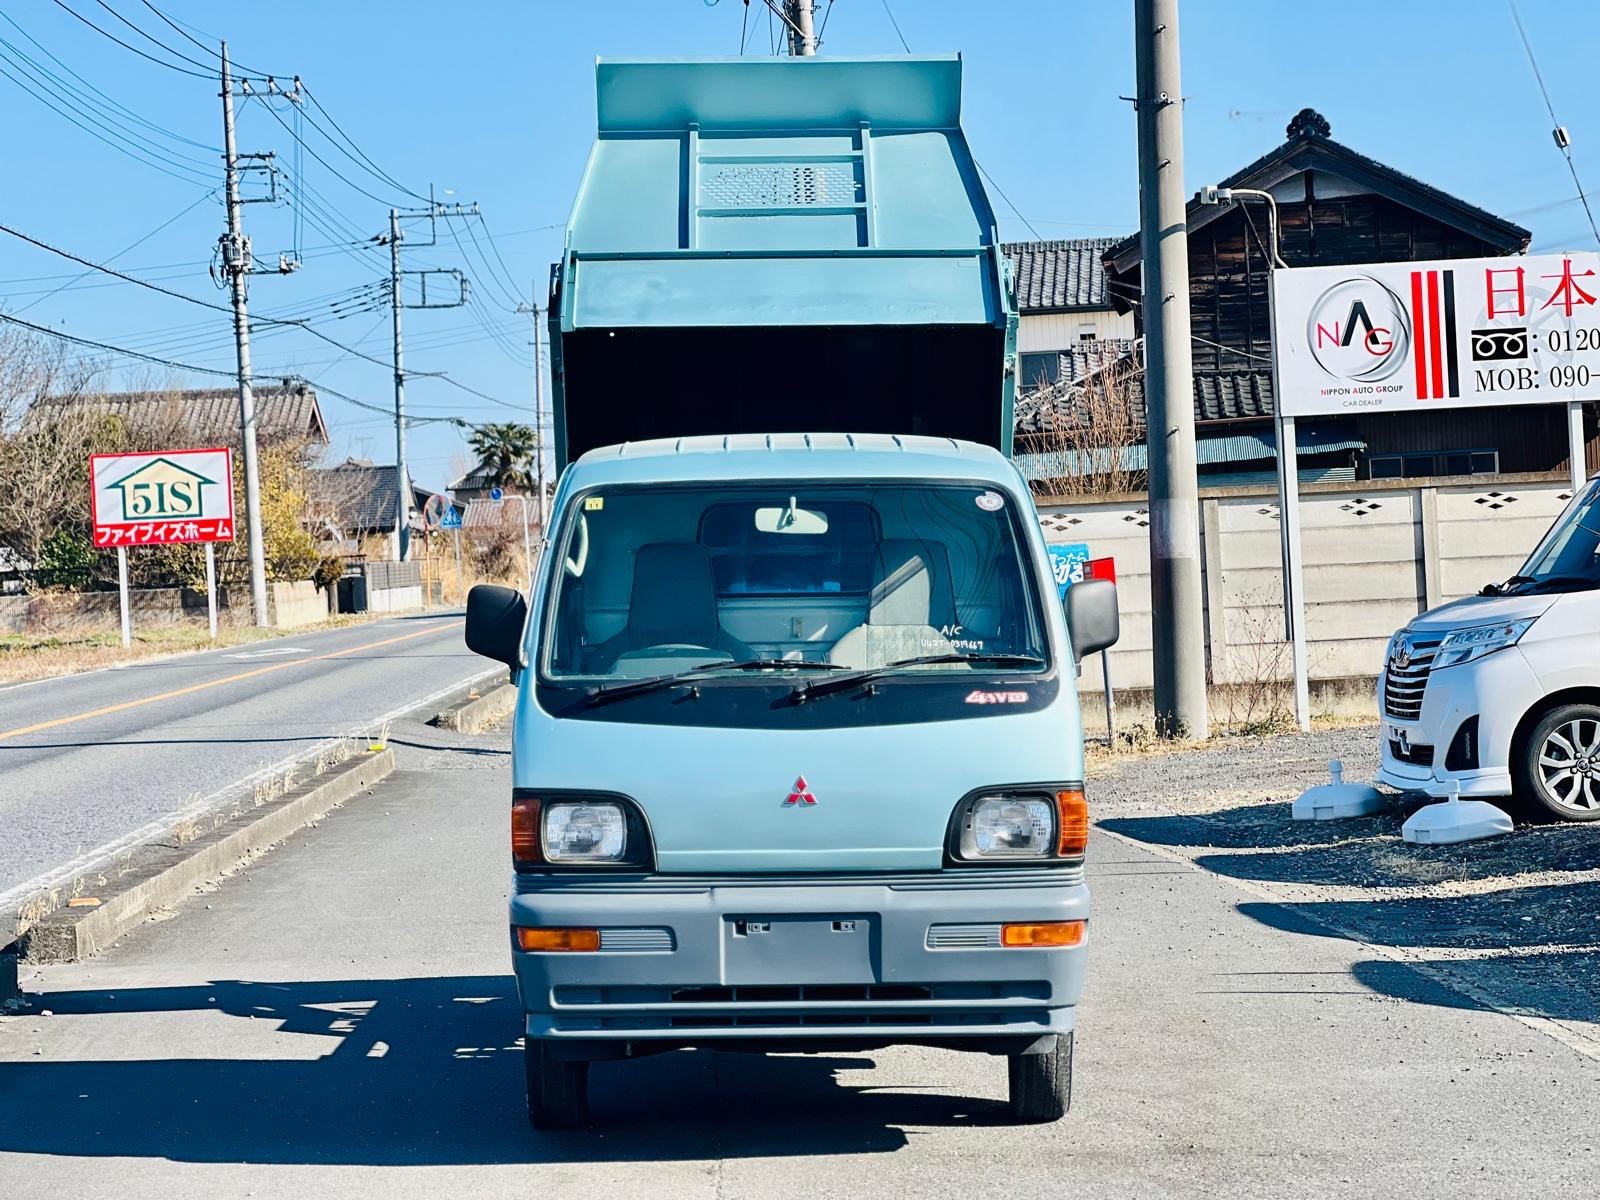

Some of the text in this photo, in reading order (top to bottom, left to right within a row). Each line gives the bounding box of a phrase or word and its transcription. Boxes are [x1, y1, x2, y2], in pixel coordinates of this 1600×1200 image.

[1486, 259, 1597, 320] 日本
[1548, 328, 1600, 352] 0120
[1321, 385, 1403, 396] NIPPON AUTO GROUP
[1475, 367, 1539, 392] MOB:
[132, 481, 193, 515] 5IS
[96, 521, 232, 545] ファイブイズホーム
[941, 624, 963, 636] A/C
[964, 690, 1029, 704] 4WD
